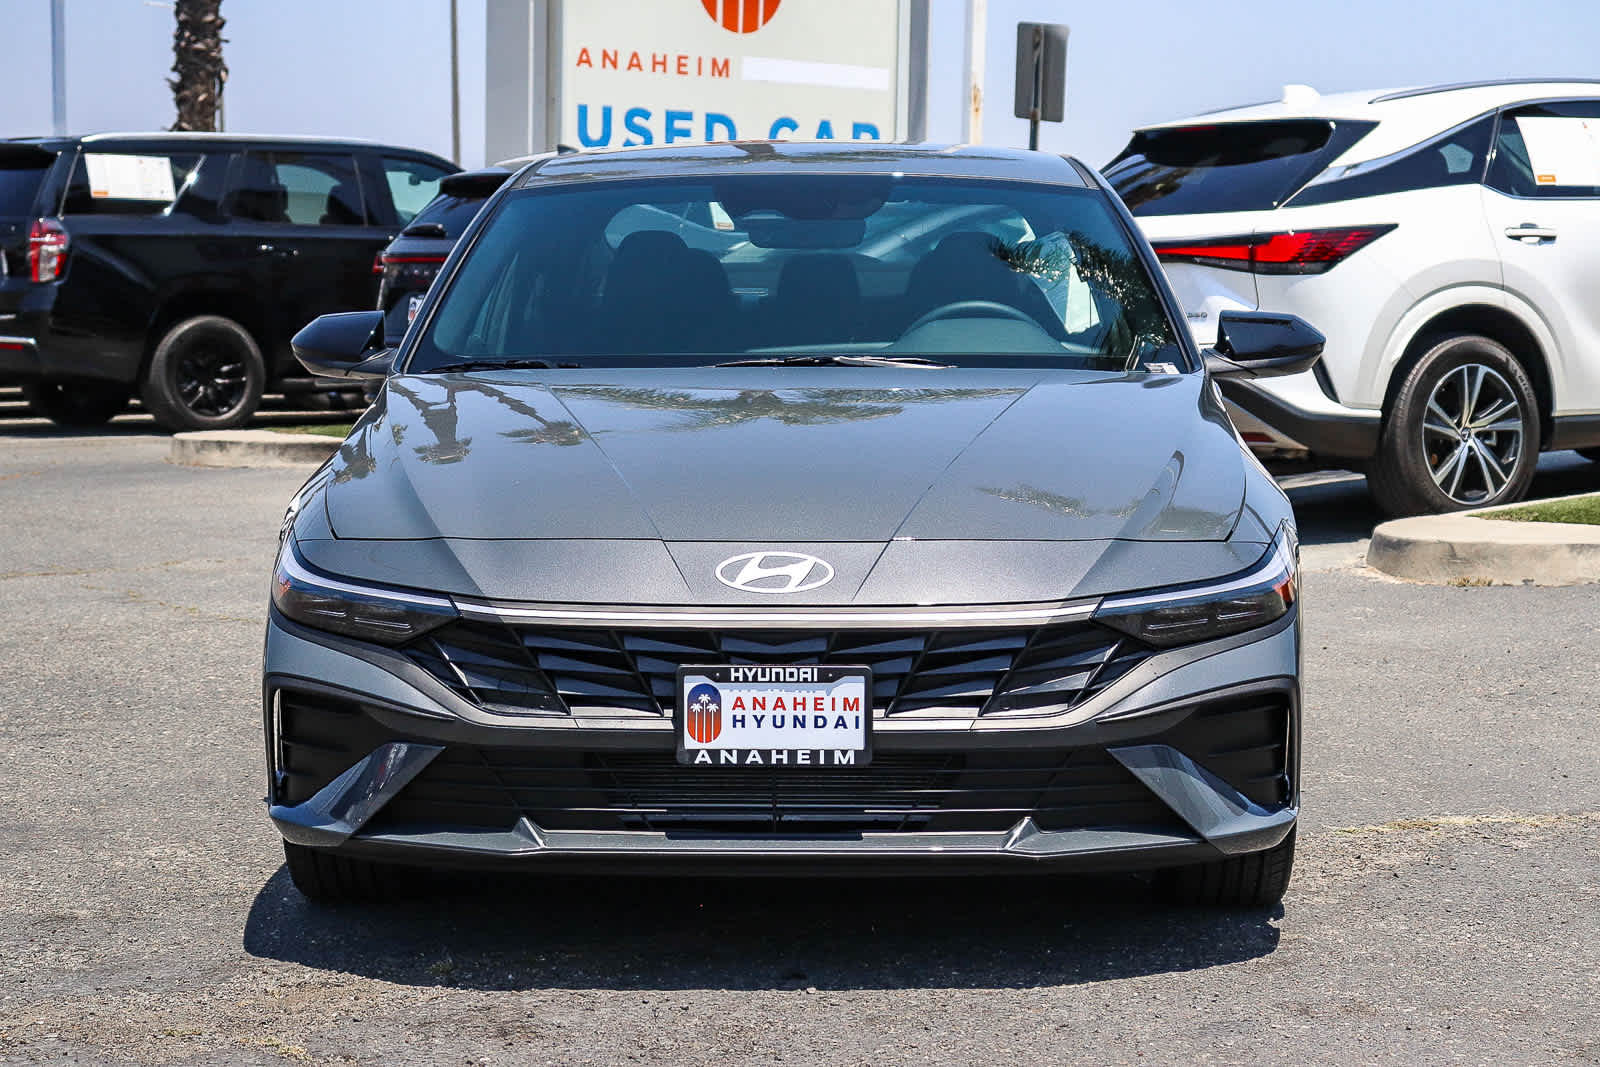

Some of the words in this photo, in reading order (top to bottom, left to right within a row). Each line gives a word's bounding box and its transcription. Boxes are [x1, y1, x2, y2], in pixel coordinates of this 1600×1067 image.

[576, 47, 731, 78] ANAHEIM
[577, 104, 737, 148] USED
[730, 667, 818, 682] HYUNDAI
[732, 696, 860, 711] ANAHEIM
[732, 714, 860, 729] HYUNDAI
[694, 750, 855, 765] ANAHEIM
